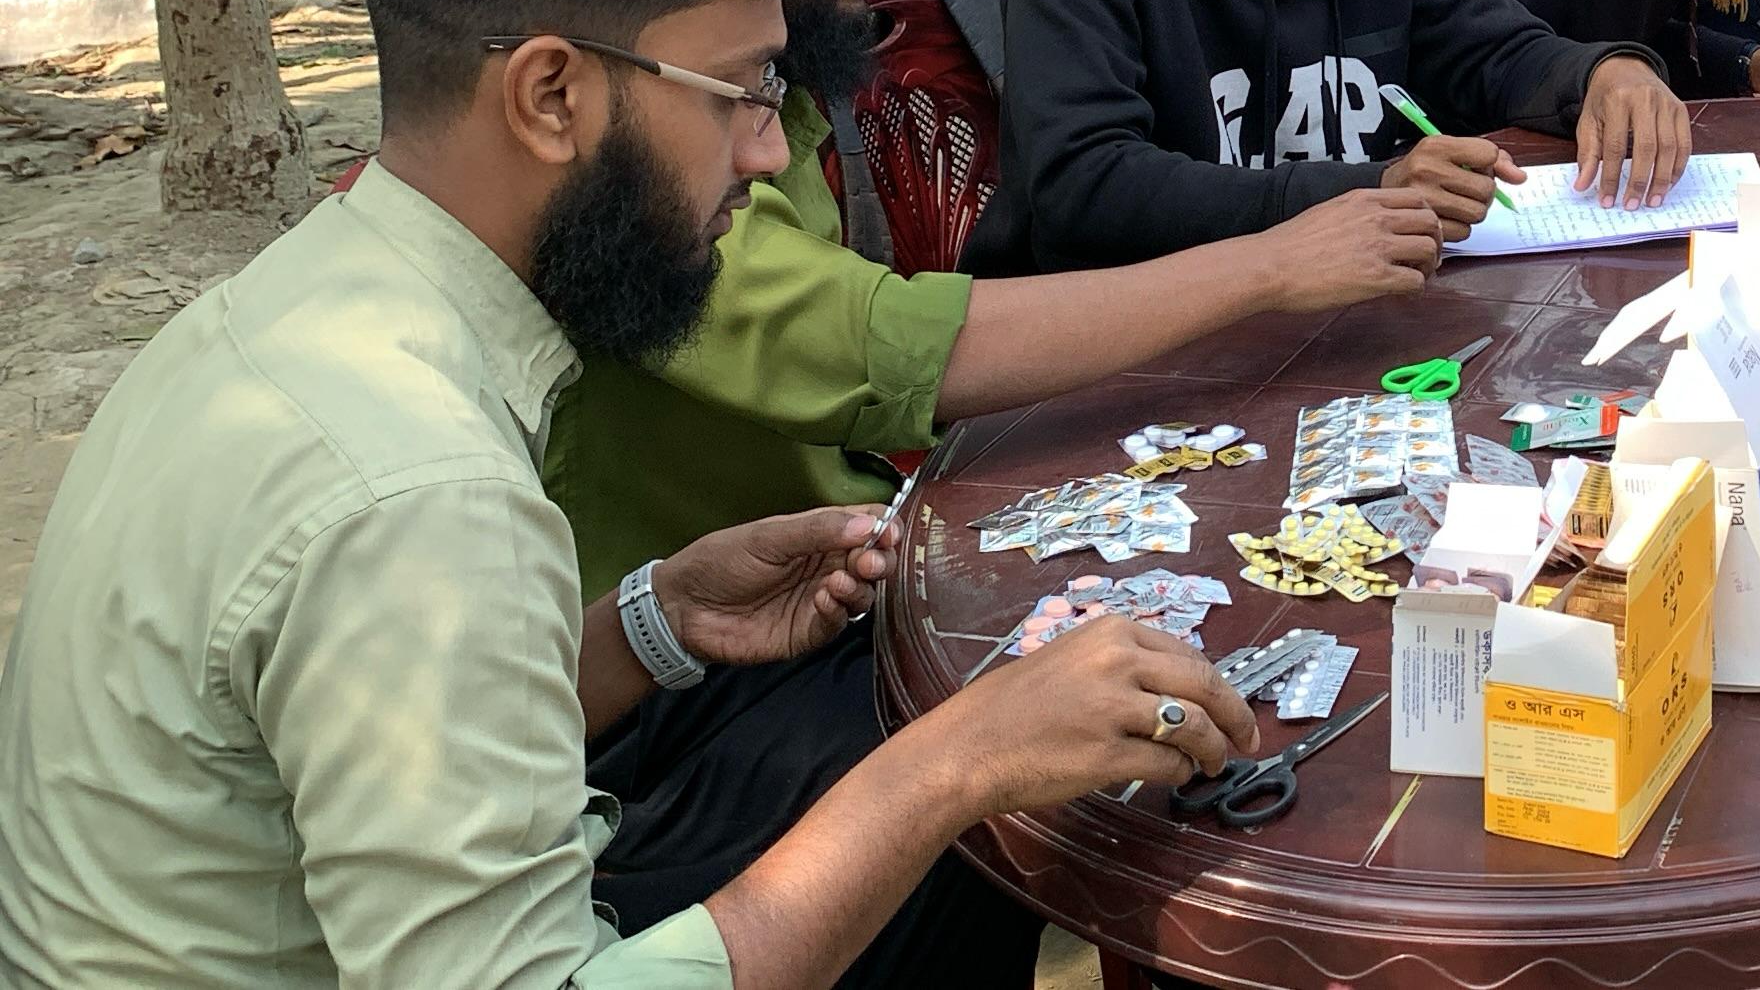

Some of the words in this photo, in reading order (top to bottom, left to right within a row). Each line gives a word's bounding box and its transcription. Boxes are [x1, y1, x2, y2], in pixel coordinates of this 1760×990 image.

[1504, 697, 1516, 710] ও
[1523, 699, 1552, 716] আর
[1559, 707, 1586, 721] এস
